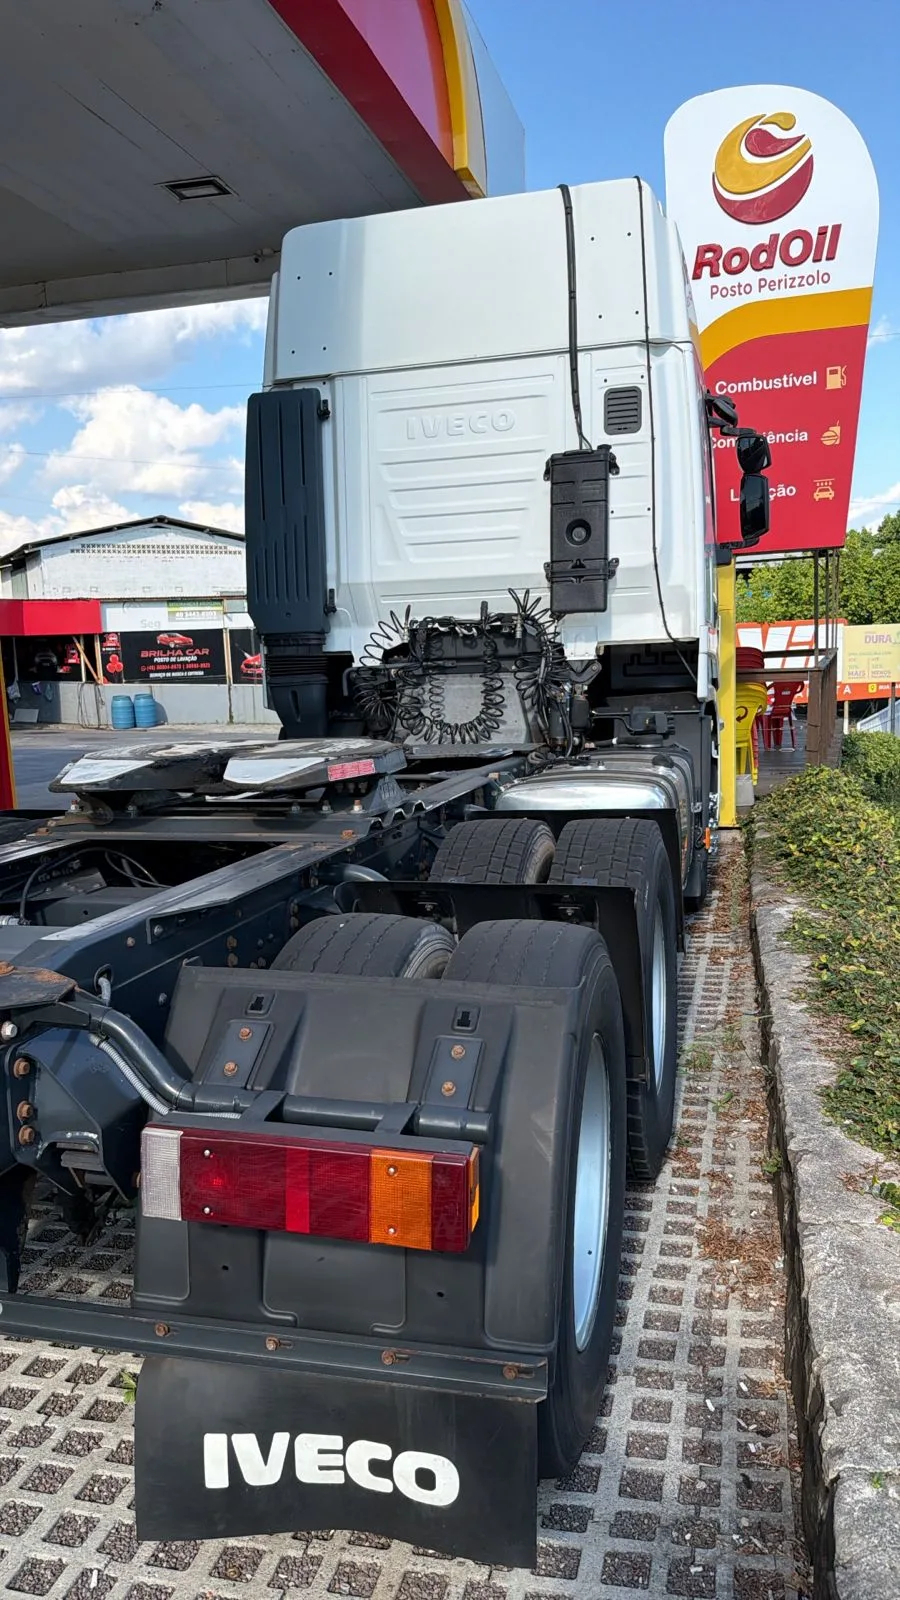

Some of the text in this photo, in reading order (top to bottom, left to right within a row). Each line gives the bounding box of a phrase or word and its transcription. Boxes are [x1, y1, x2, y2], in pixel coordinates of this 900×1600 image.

[692, 223, 842, 280] RodOil
[710, 269, 831, 300] Posto Perizzolo
[715, 371, 818, 395] Combustível
[406, 408, 515, 440] IVECO
[140, 648, 210, 658] BRILHA CAR
[177, 655, 197, 663] LAVAÇÃO
[203, 1431, 461, 1507] IVECO
